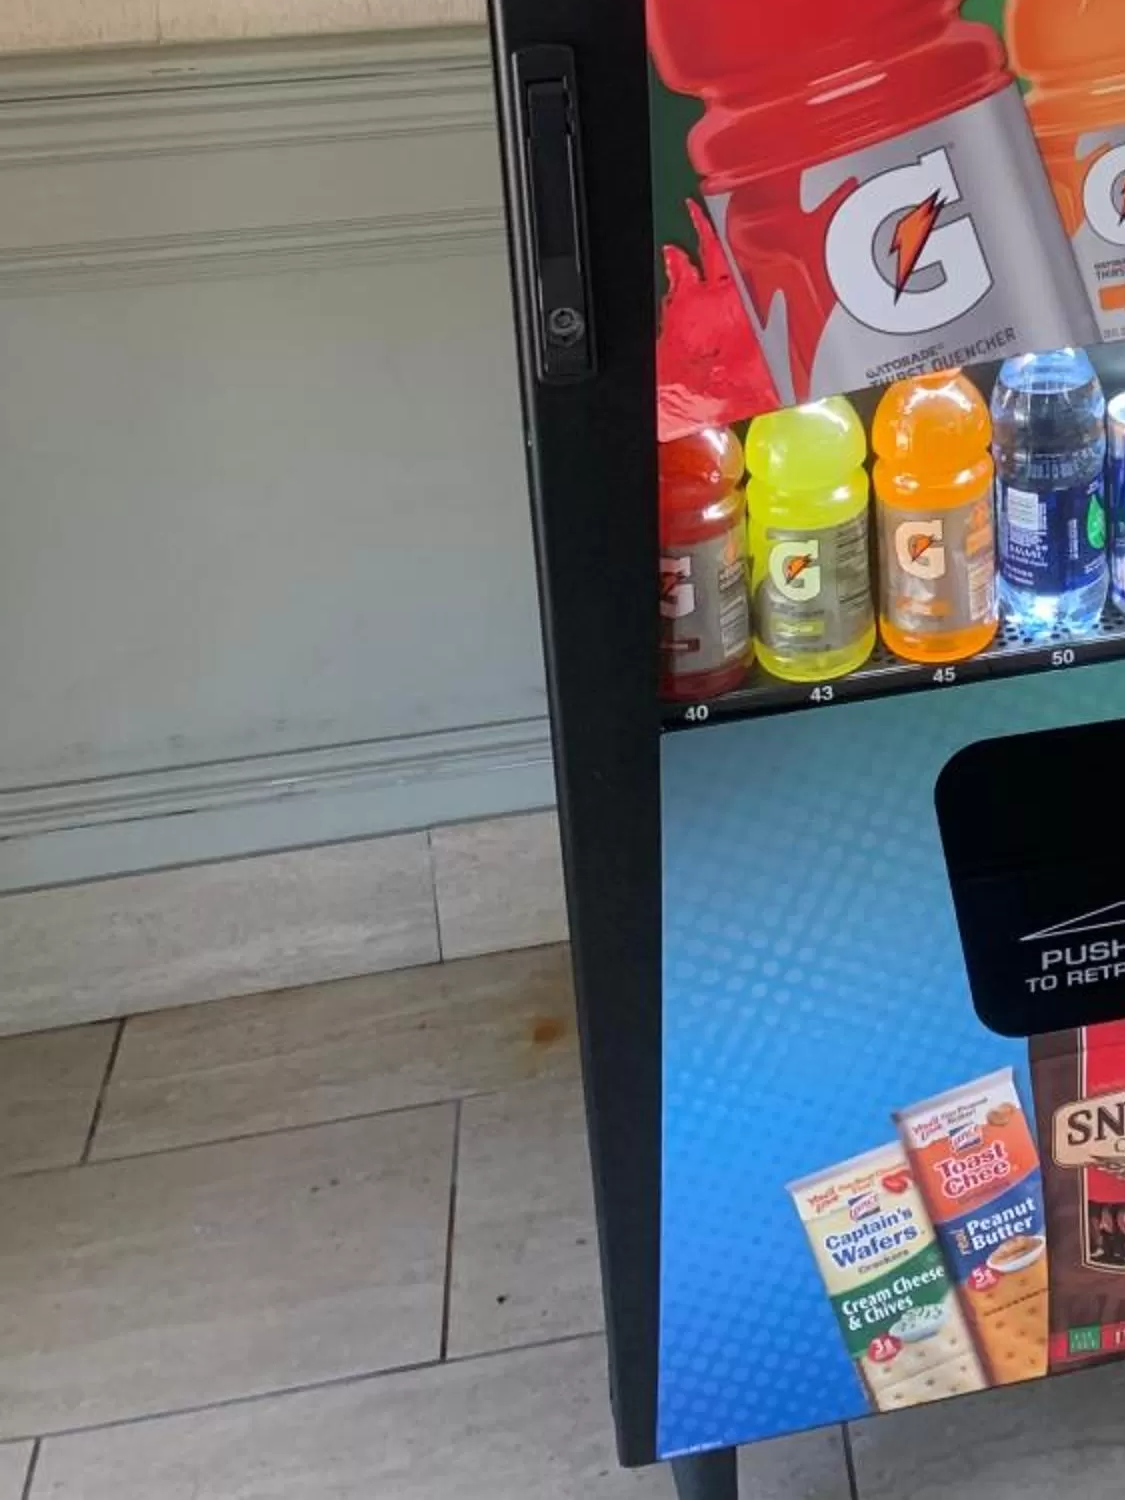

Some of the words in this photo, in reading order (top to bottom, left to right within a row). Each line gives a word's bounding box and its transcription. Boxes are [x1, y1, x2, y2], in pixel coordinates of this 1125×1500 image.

[823, 145, 996, 337] G
[931, 327, 1017, 373] QUENCHER
[895, 518, 946, 581] G
[767, 538, 822, 602] G
[932, 668, 956, 684] 45
[1052, 649, 1075, 665] 50
[683, 705, 710, 722] 40
[810, 686, 834, 703] 43
[1024, 973, 1059, 994] TO
[936, 1141, 1006, 1178] Toast
[944, 1160, 1010, 1197] Chee
[825, 1206, 913, 1250] Captain's
[966, 1196, 1037, 1237] Peanut
[970, 1215, 1034, 1251] Butter
[831, 1224, 919, 1269] Wafers
[841, 1285, 892, 1316] Cream
[892, 1264, 945, 1295] Cheese
[848, 1315, 863, 1332] &
[863, 1294, 914, 1325] Chives
